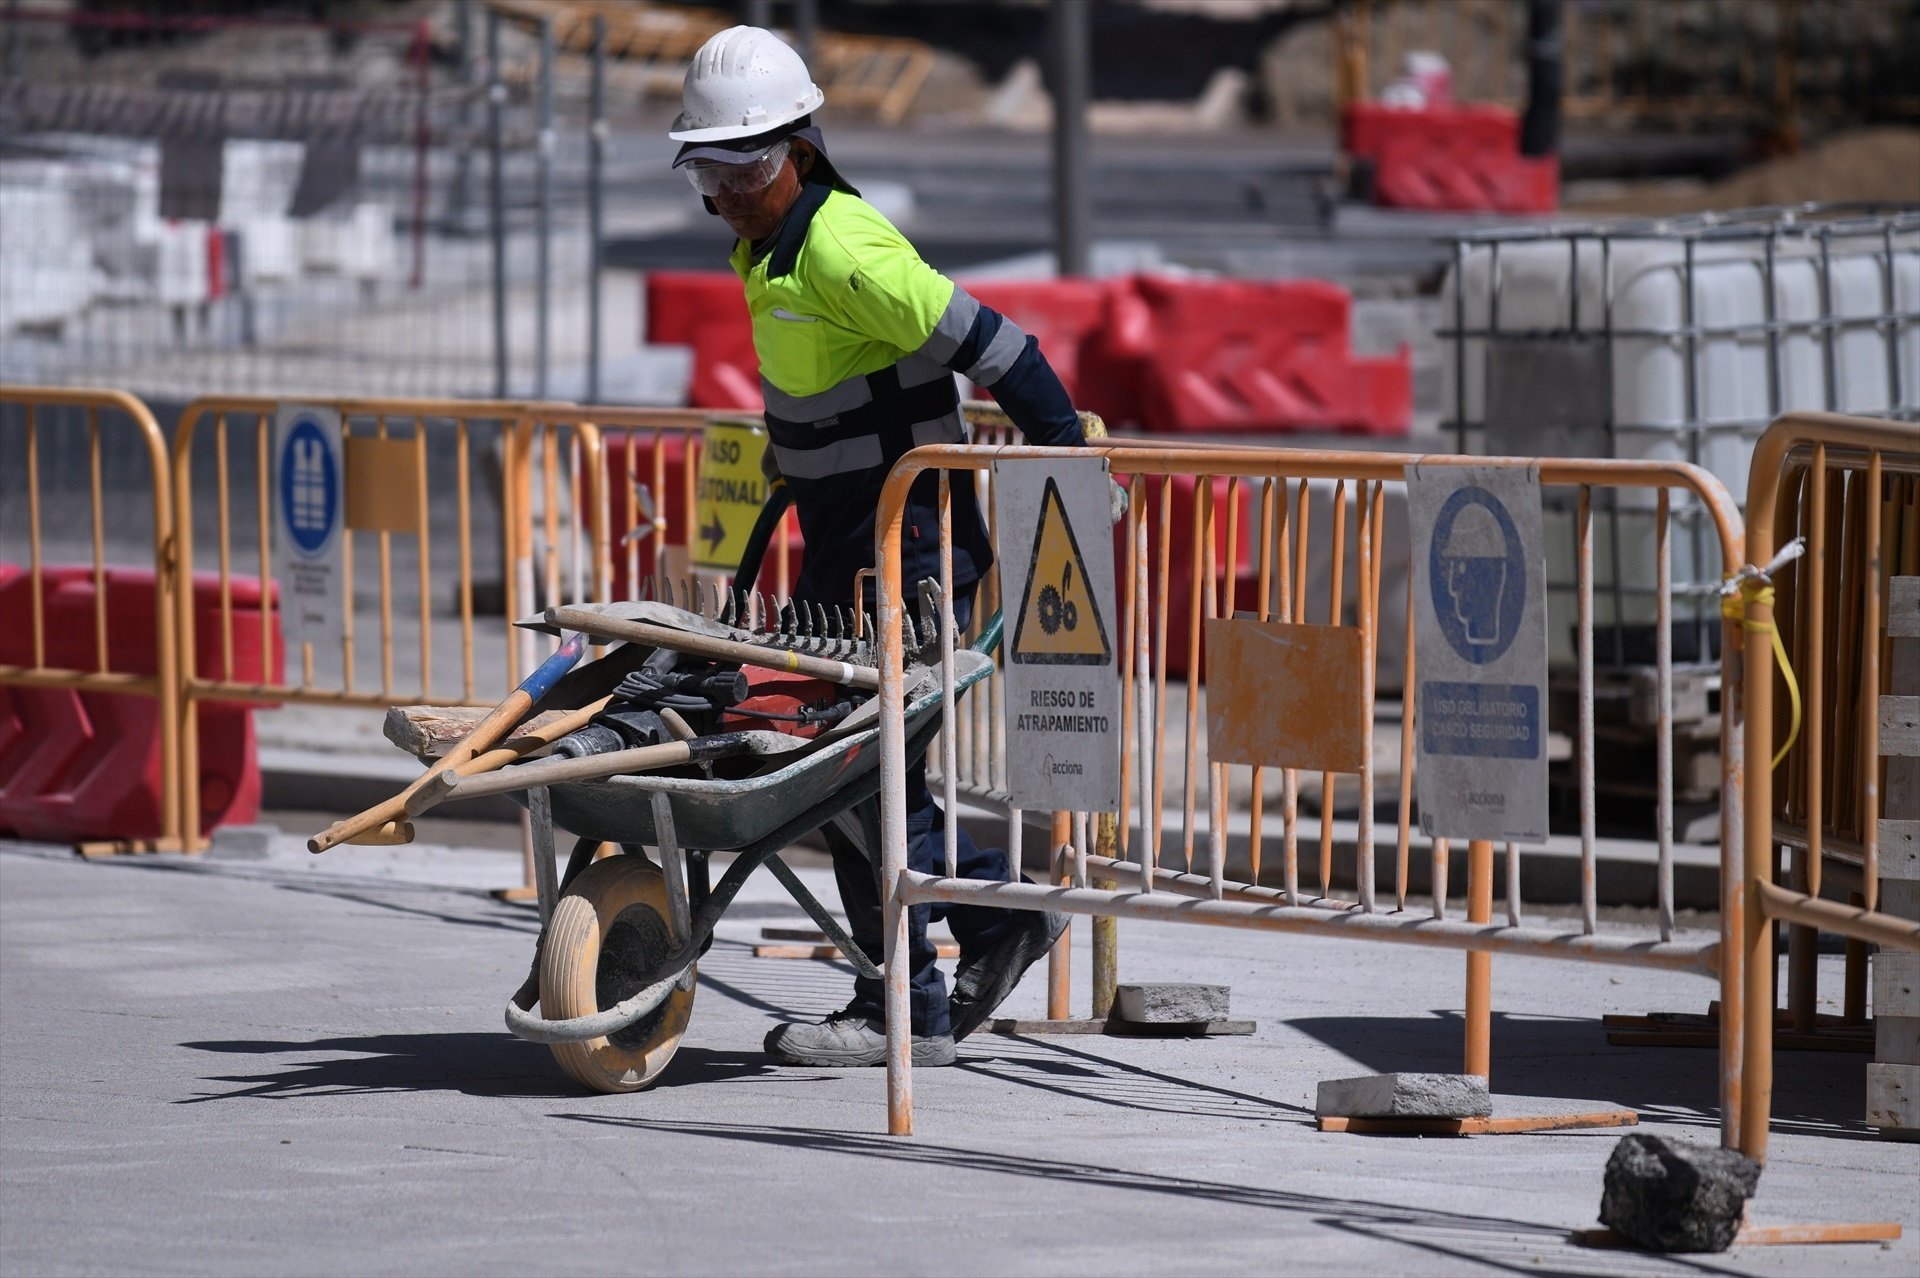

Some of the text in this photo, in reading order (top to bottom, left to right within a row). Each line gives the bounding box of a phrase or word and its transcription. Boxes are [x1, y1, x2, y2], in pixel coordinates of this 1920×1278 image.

[1030, 690, 1095, 708] RIESGO DE
[1433, 699, 1528, 718] USO OBLIGATORIO
[1017, 714, 1108, 733] ATRAPAMIENTO
[1432, 722, 1530, 741] CASCO SEGURIDAD
[1052, 759, 1083, 775] acciona
[1469, 790, 1505, 806] acciona
